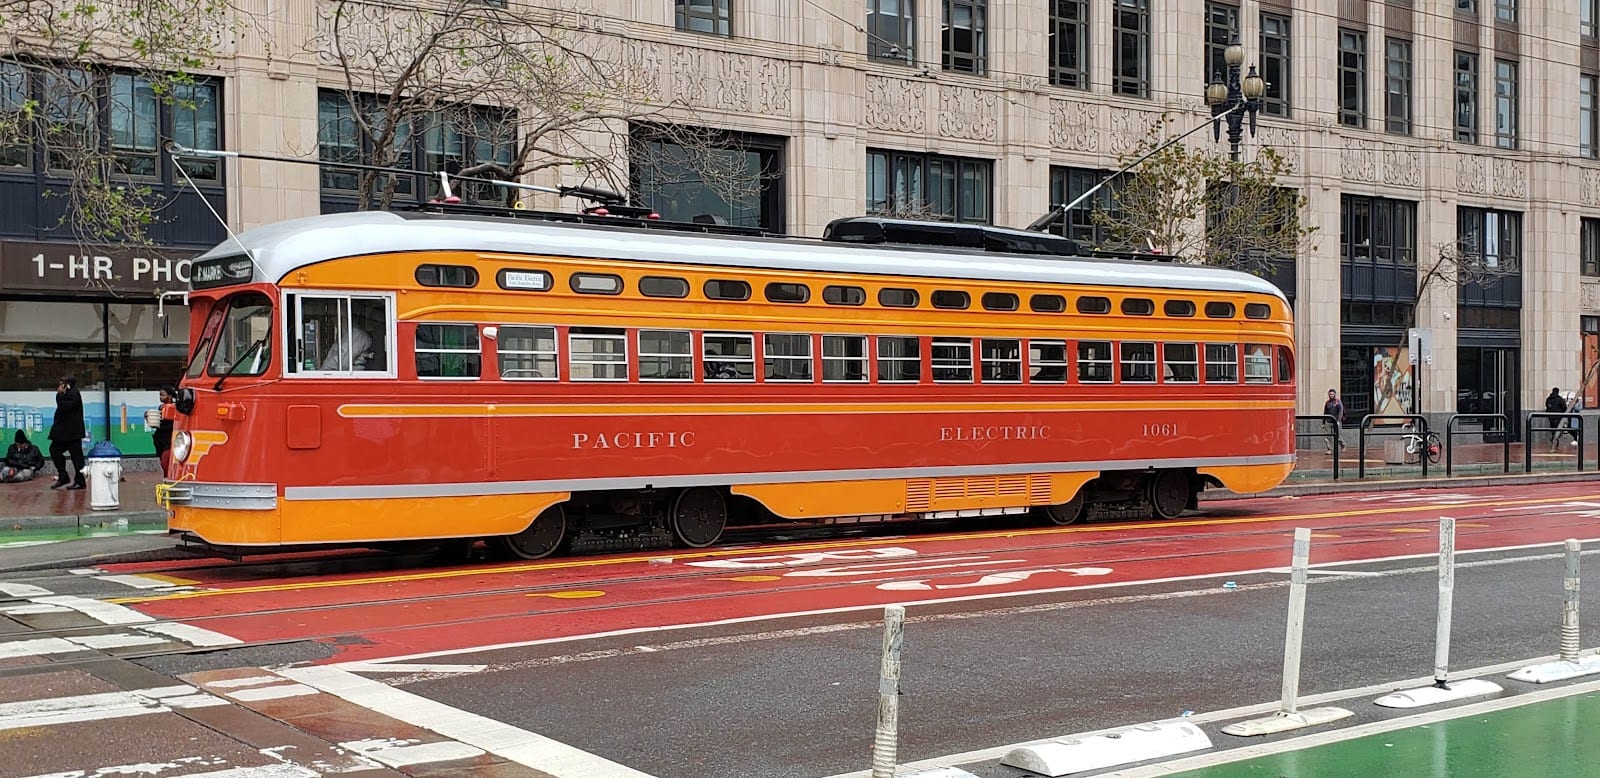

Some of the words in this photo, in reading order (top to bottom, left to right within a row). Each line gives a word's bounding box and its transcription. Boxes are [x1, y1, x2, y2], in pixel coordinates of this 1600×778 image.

[31, 253, 113, 280] 1-HR
[571, 431, 696, 449] PACIFIC
[939, 425, 1051, 441] ELECTRIC
[1142, 423, 1179, 437] 1061
